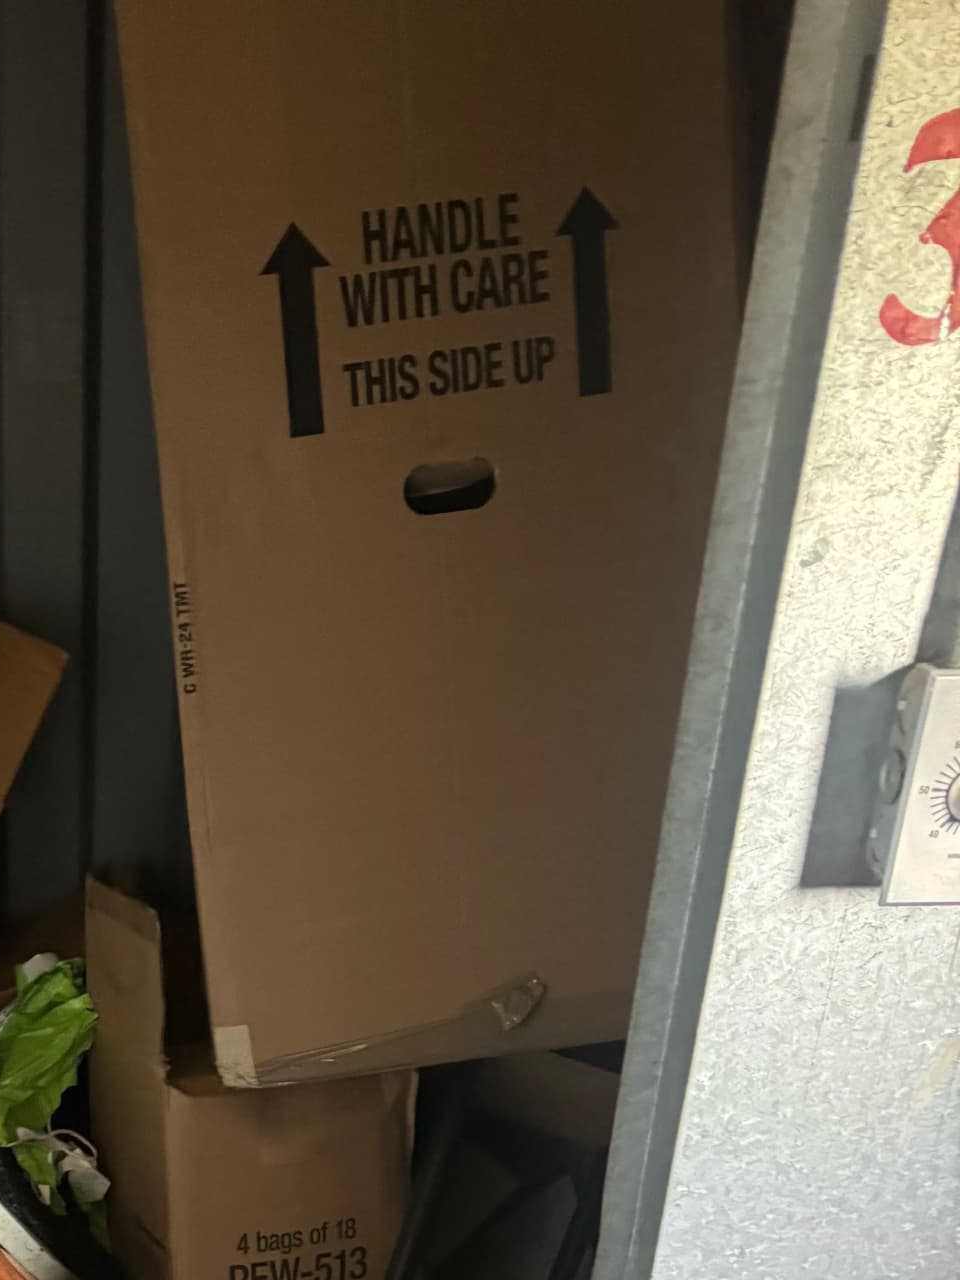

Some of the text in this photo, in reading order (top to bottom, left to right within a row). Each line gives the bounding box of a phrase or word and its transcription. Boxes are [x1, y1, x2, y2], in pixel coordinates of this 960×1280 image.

[361, 192, 520, 265] HANDLE
[338, 250, 551, 328] WITH CARE
[343, 335, 556, 407] THIS SIDE UP
[236, 1217, 357, 1254] 4 bags of 18
